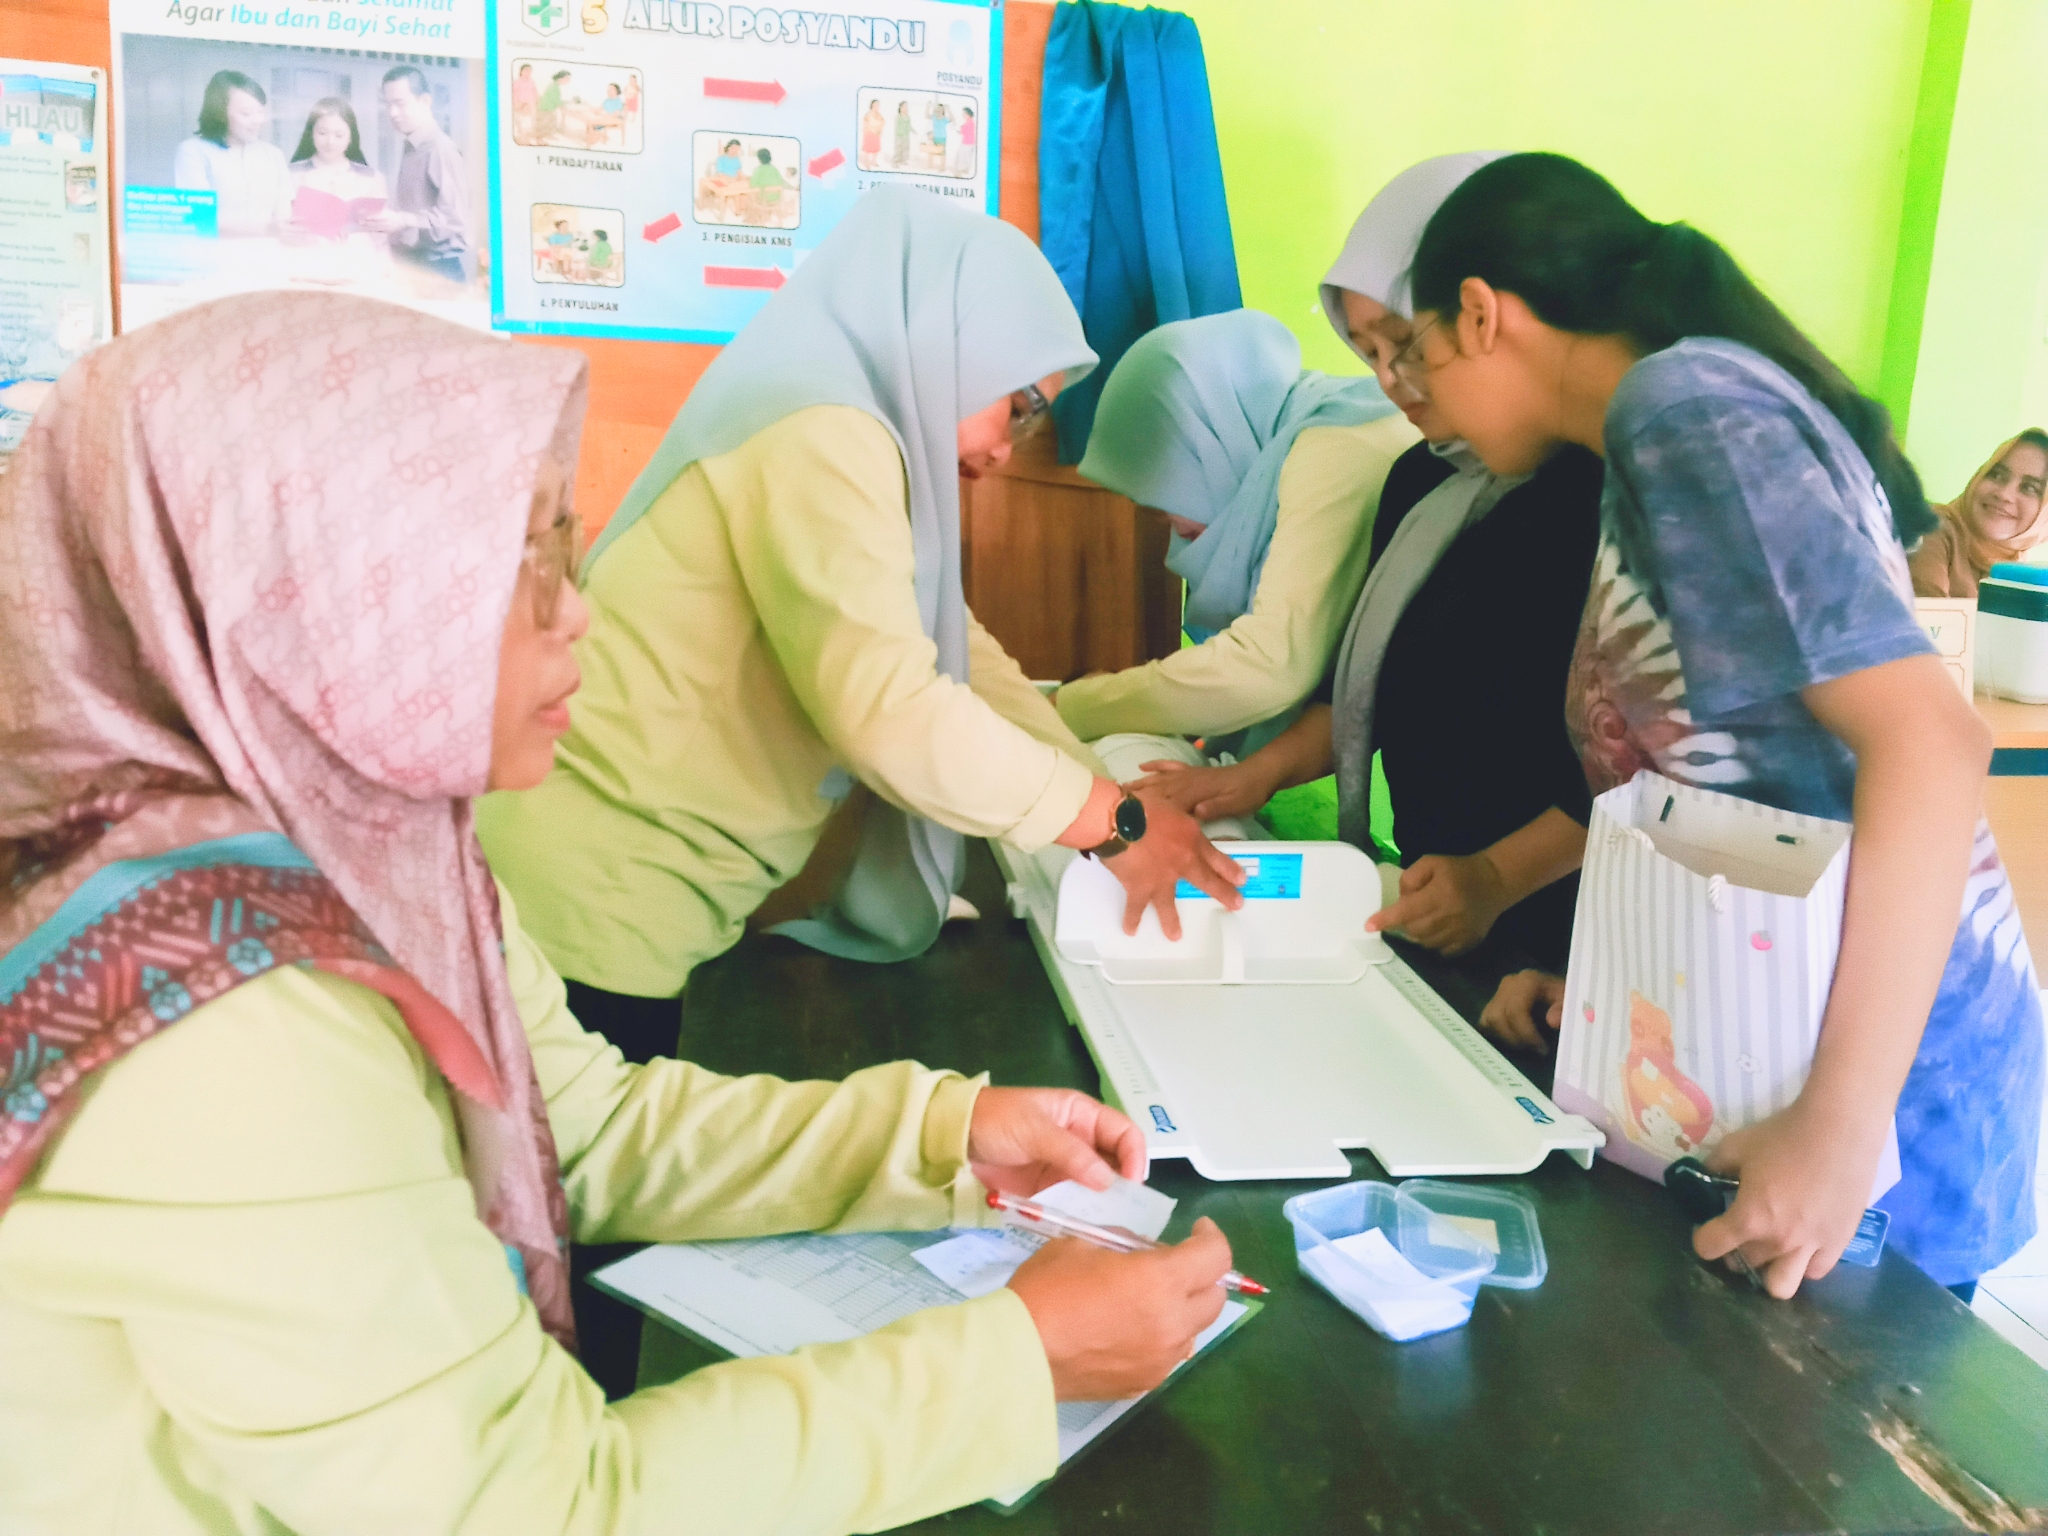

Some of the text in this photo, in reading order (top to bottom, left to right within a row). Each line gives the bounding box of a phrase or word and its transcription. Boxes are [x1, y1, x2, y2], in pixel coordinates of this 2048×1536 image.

[357, 0, 453, 11] amat
[166, 0, 451, 39] Agar Ibu dan Bayi Sehat
[581, 0, 925, 54] 5 ALUR POSYANDU
[937, 71, 983, 85] POSYANDU
[5, 103, 79, 132] HIJAU
[548, 156, 623, 172] PENDAFTARAN
[943, 186, 976, 198] BALITA
[714, 233, 767, 245] PENGISIAN
[771, 236, 793, 247] KMS
[551, 298, 619, 311] PENYULUHAN
